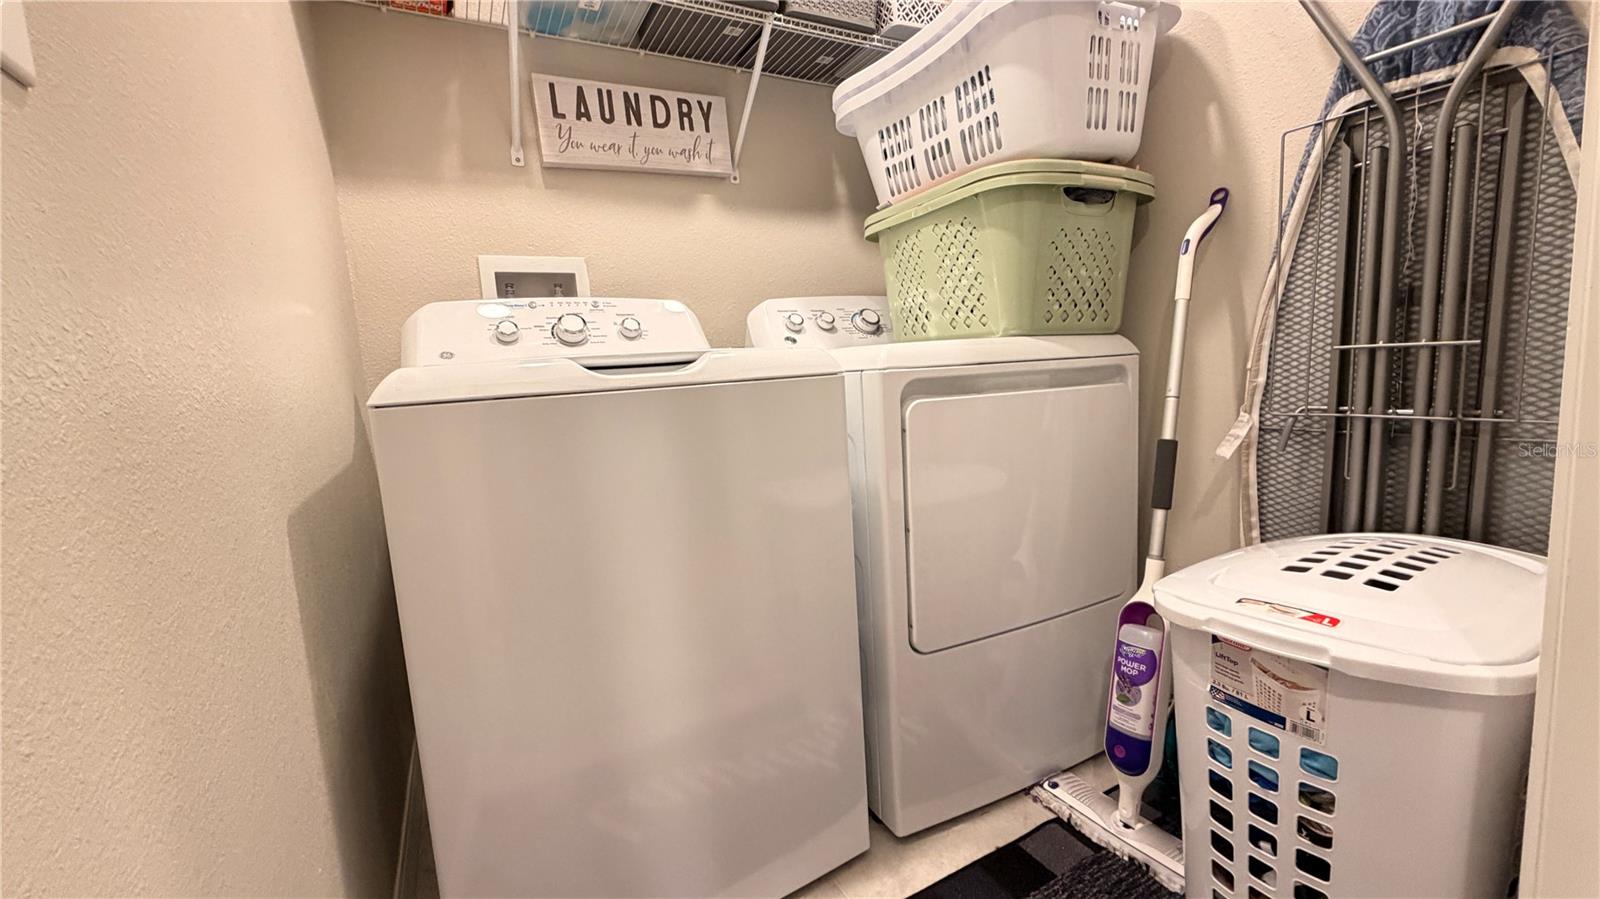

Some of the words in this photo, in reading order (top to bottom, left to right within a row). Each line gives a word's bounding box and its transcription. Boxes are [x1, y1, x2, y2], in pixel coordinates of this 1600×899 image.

[549, 82, 712, 133] LAUNDRY
[555, 123, 584, 153] You
[589, 141, 623, 156] wear
[640, 145, 664, 165] you
[668, 135, 703, 164] wash
[704, 138, 716, 164] it
[1117, 655, 1147, 672] POWER
[1120, 665, 1139, 676] MOP
[1306, 710, 1316, 723] L
